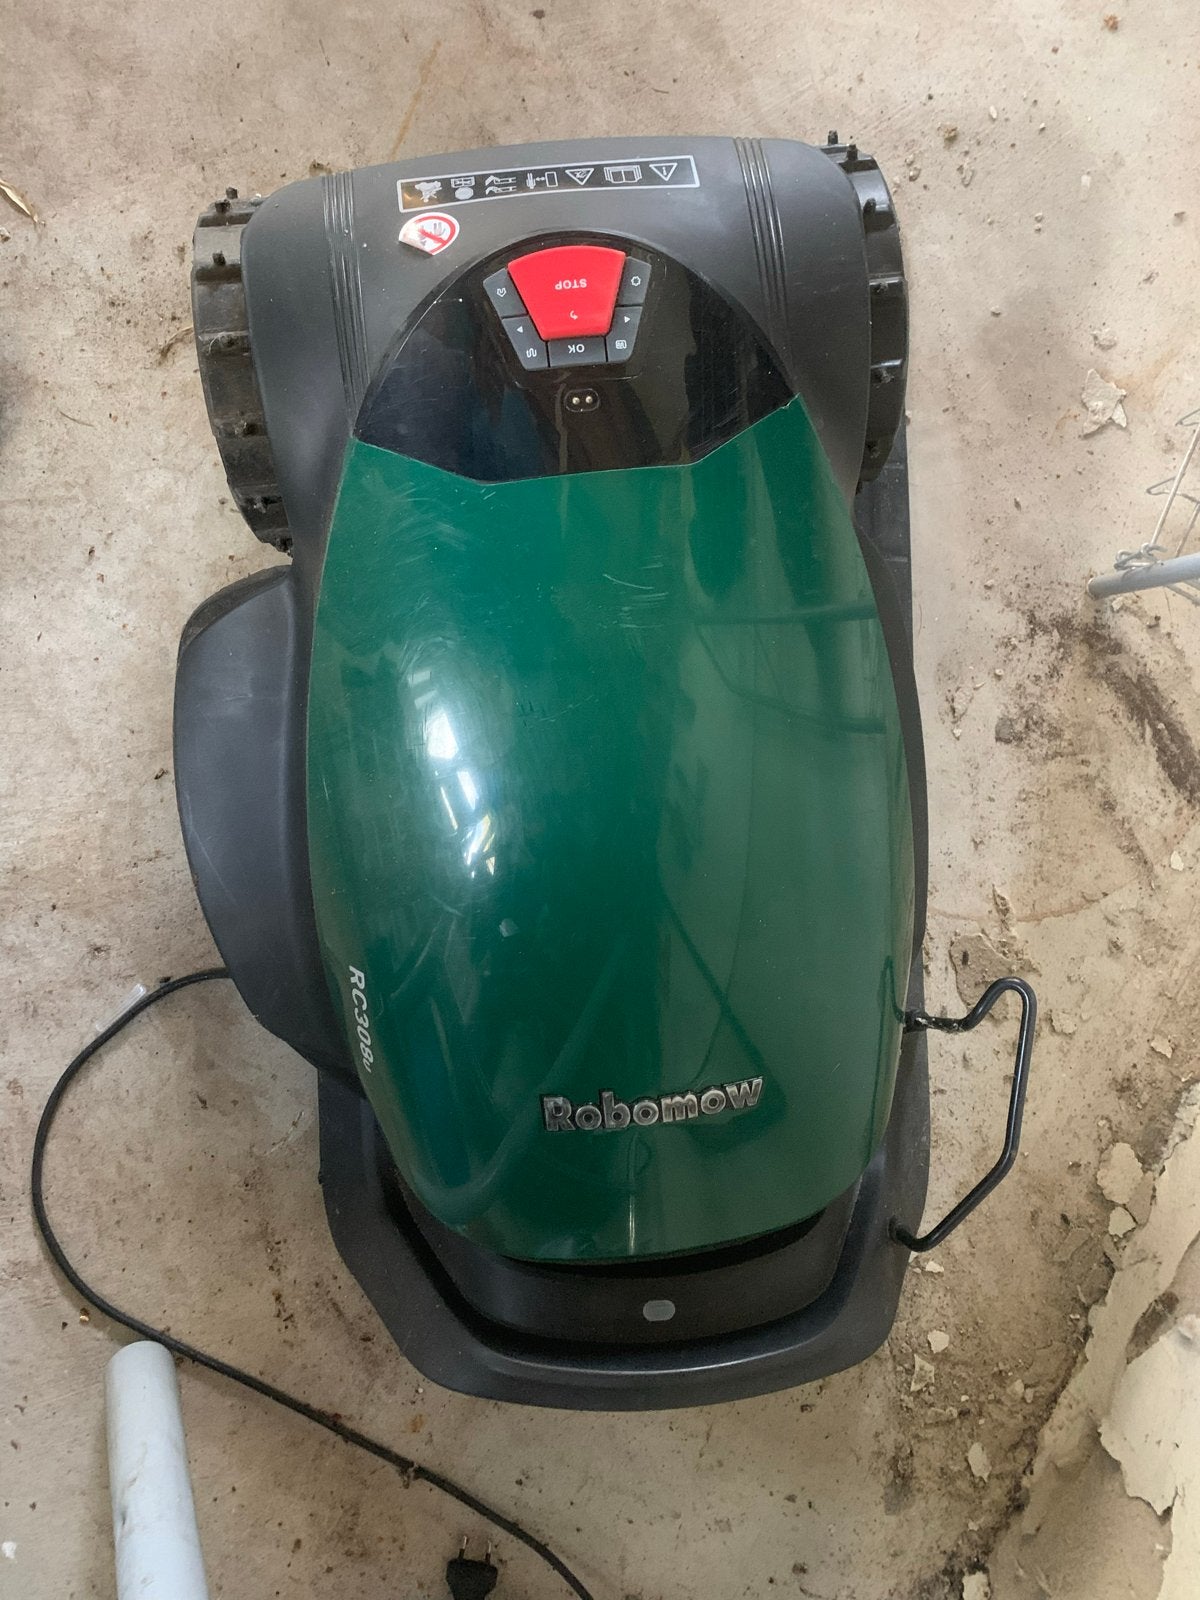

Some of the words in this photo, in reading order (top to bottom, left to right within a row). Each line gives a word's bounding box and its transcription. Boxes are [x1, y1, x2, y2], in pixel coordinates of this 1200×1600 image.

[555, 278, 587, 290] STOP
[567, 343, 585, 354] OK
[541, 1076, 764, 1132] Robomow
